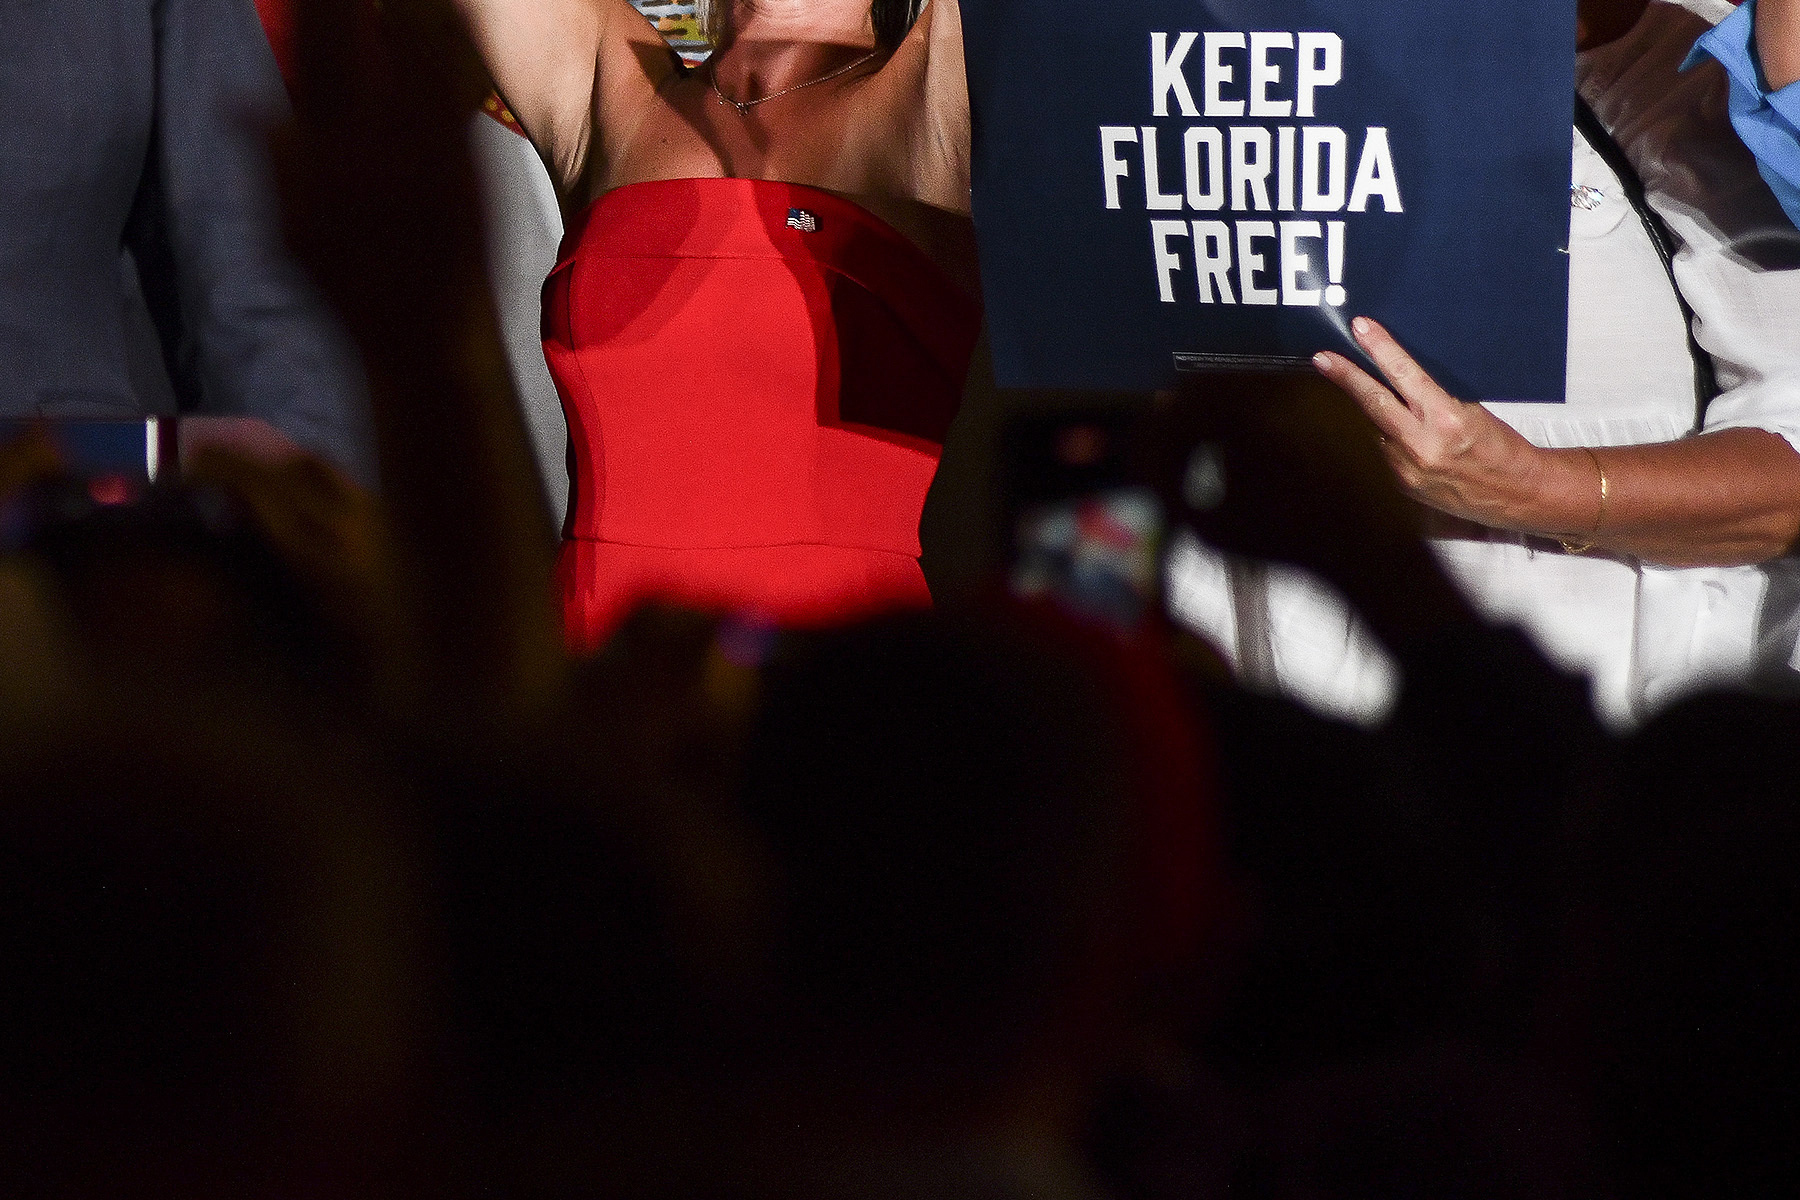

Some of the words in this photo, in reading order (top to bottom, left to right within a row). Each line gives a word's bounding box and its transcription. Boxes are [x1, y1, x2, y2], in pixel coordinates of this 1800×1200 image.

[1150, 32, 1343, 117] KEEP
[1099, 126, 1404, 213] FLORIDA
[1150, 220, 1347, 306] FREE!
